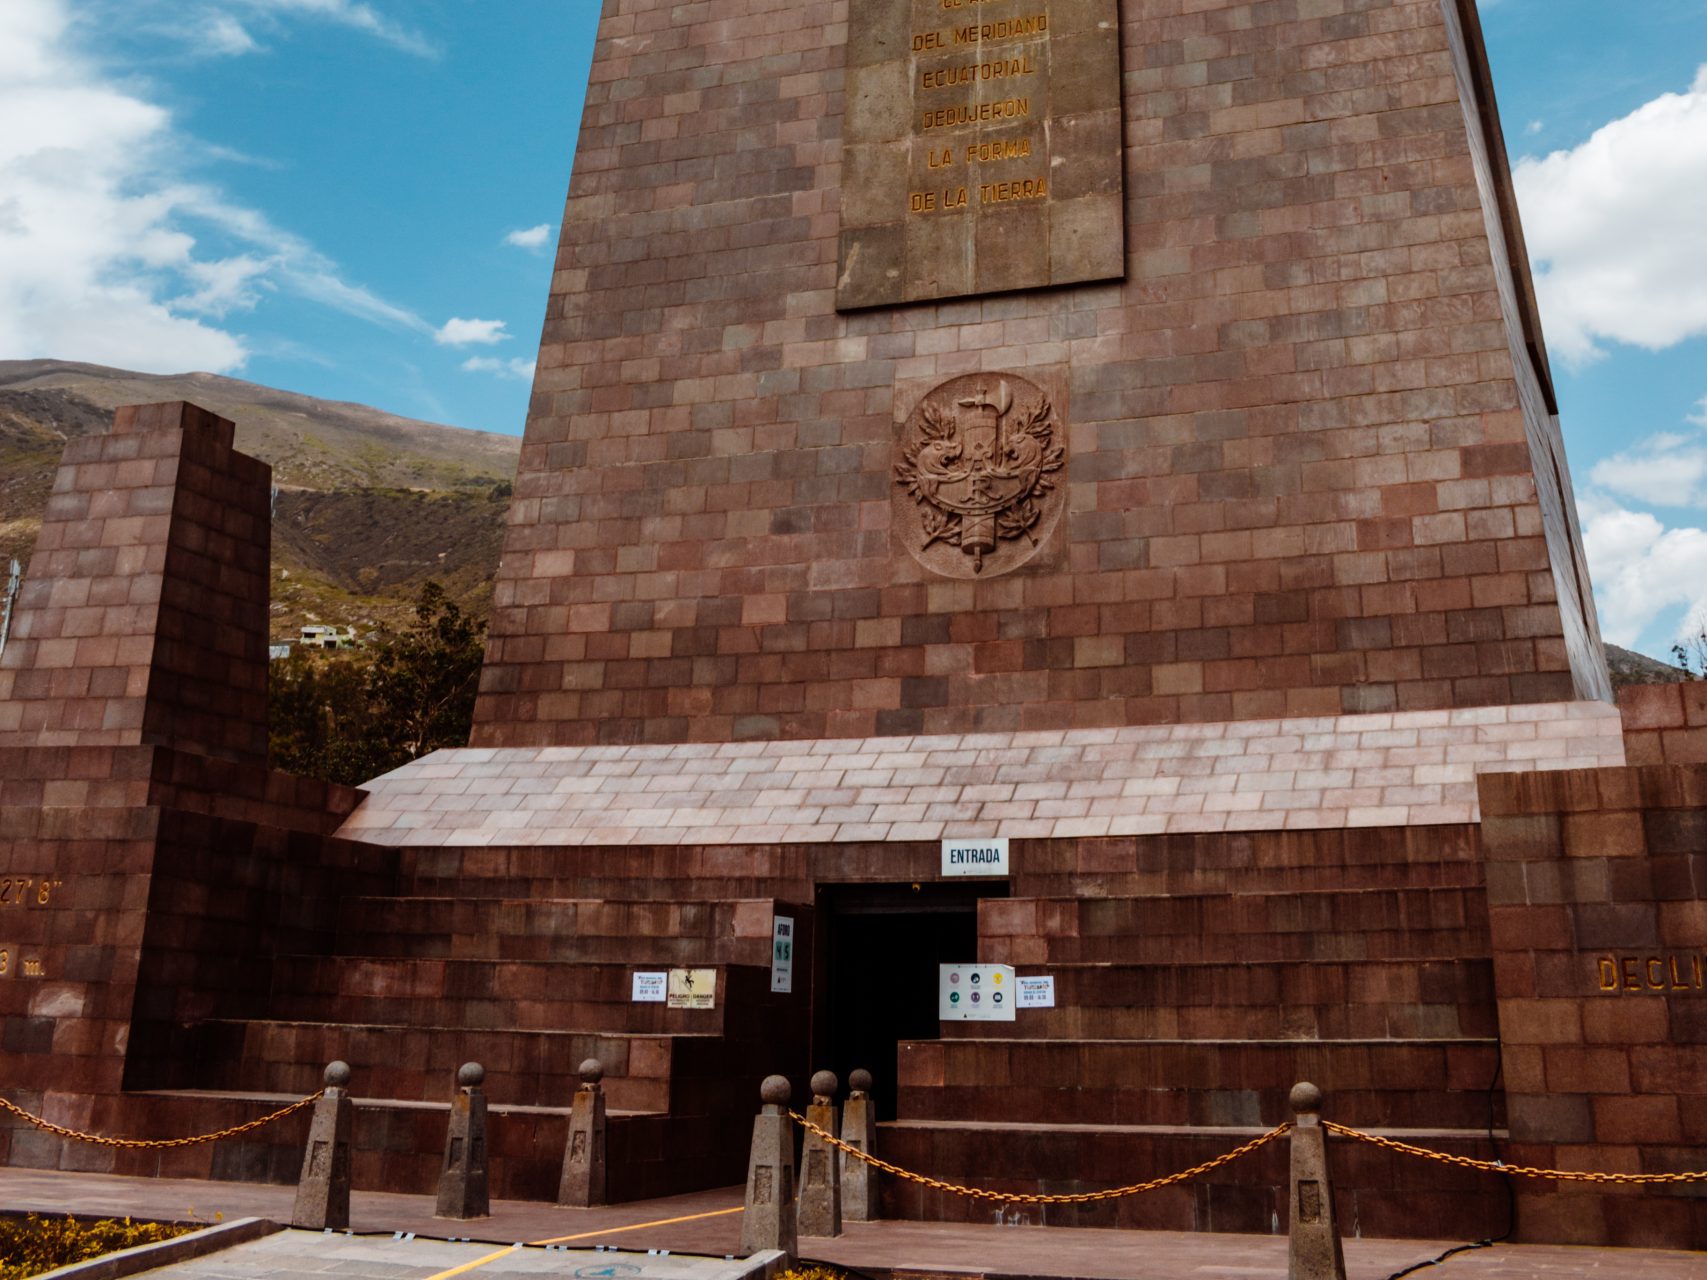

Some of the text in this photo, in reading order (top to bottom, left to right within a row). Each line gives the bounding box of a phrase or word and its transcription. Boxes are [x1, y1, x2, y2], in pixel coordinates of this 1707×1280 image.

[912, 15, 1047, 52] DEL MERIDIANO
[922, 58, 1035, 89] ECUATORIAL
[923, 98, 1028, 130] DEDUJERON
[928, 138, 1031, 169] LA FORMA
[911, 178, 1047, 213] DE LA TIERRA
[950, 848, 1001, 864] ENTRADA
[1597, 952, 1707, 992] DECLI
